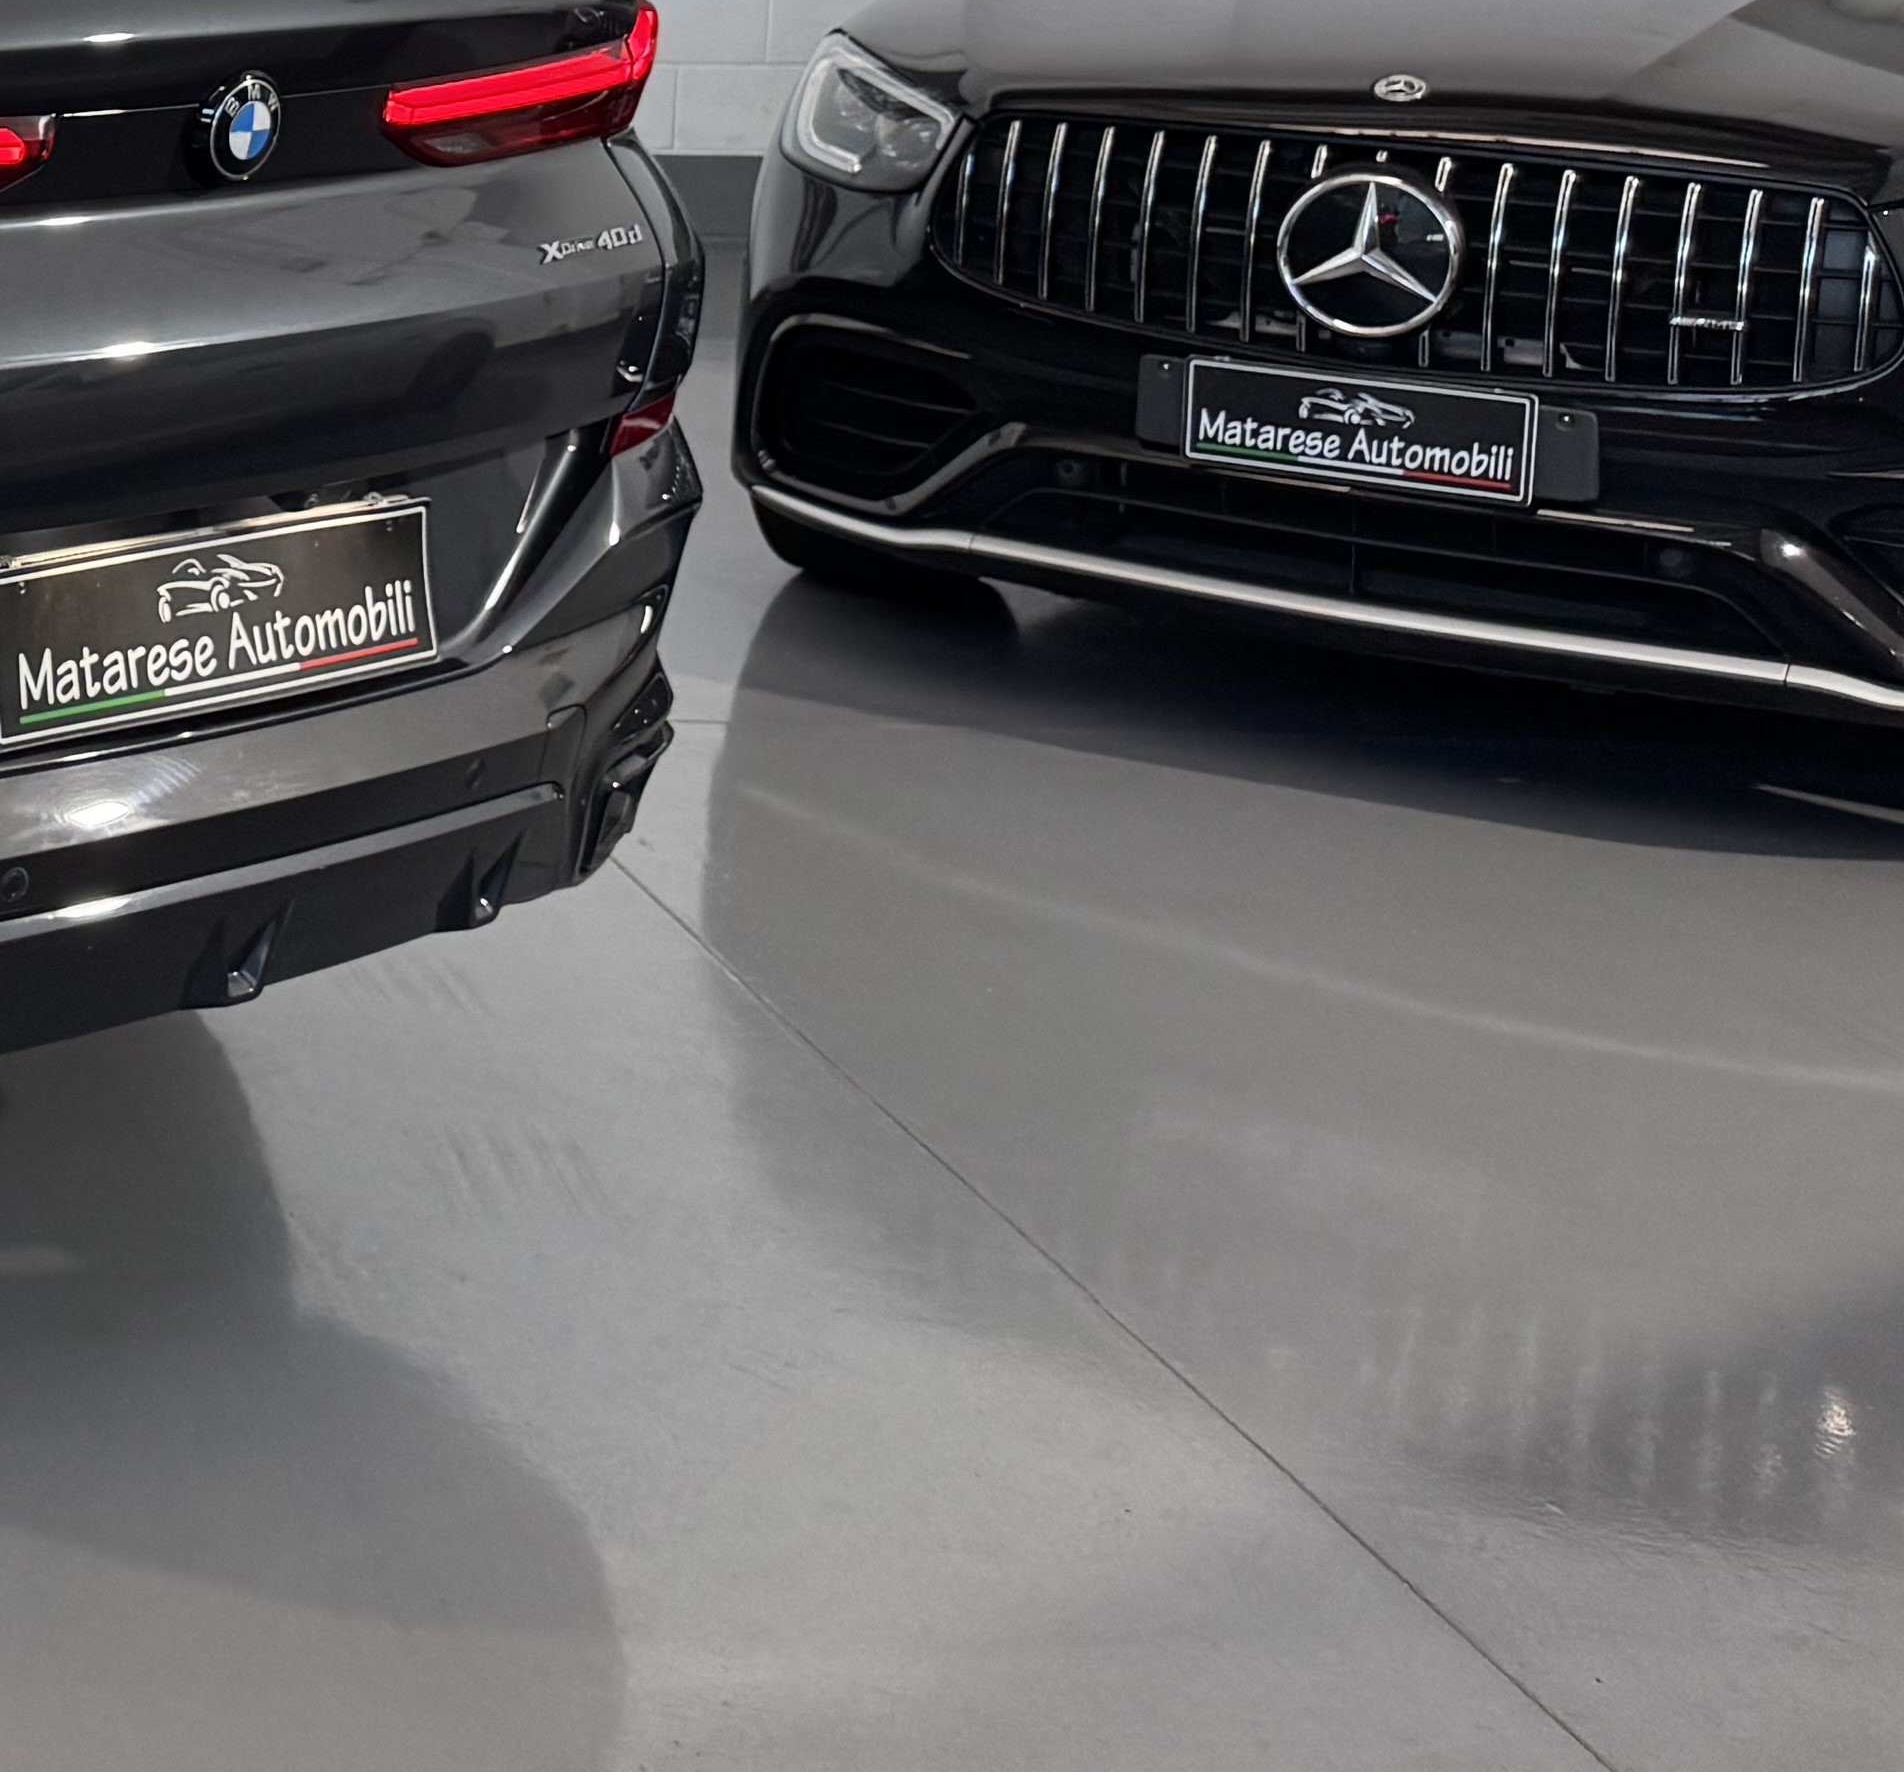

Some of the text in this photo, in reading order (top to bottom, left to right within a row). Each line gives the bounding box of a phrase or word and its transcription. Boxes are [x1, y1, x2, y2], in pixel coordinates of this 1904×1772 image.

[224, 81, 279, 118] BMW
[1197, 406, 1515, 482] Matarese Automobili
[17, 578, 418, 711] Matarese Automobili
